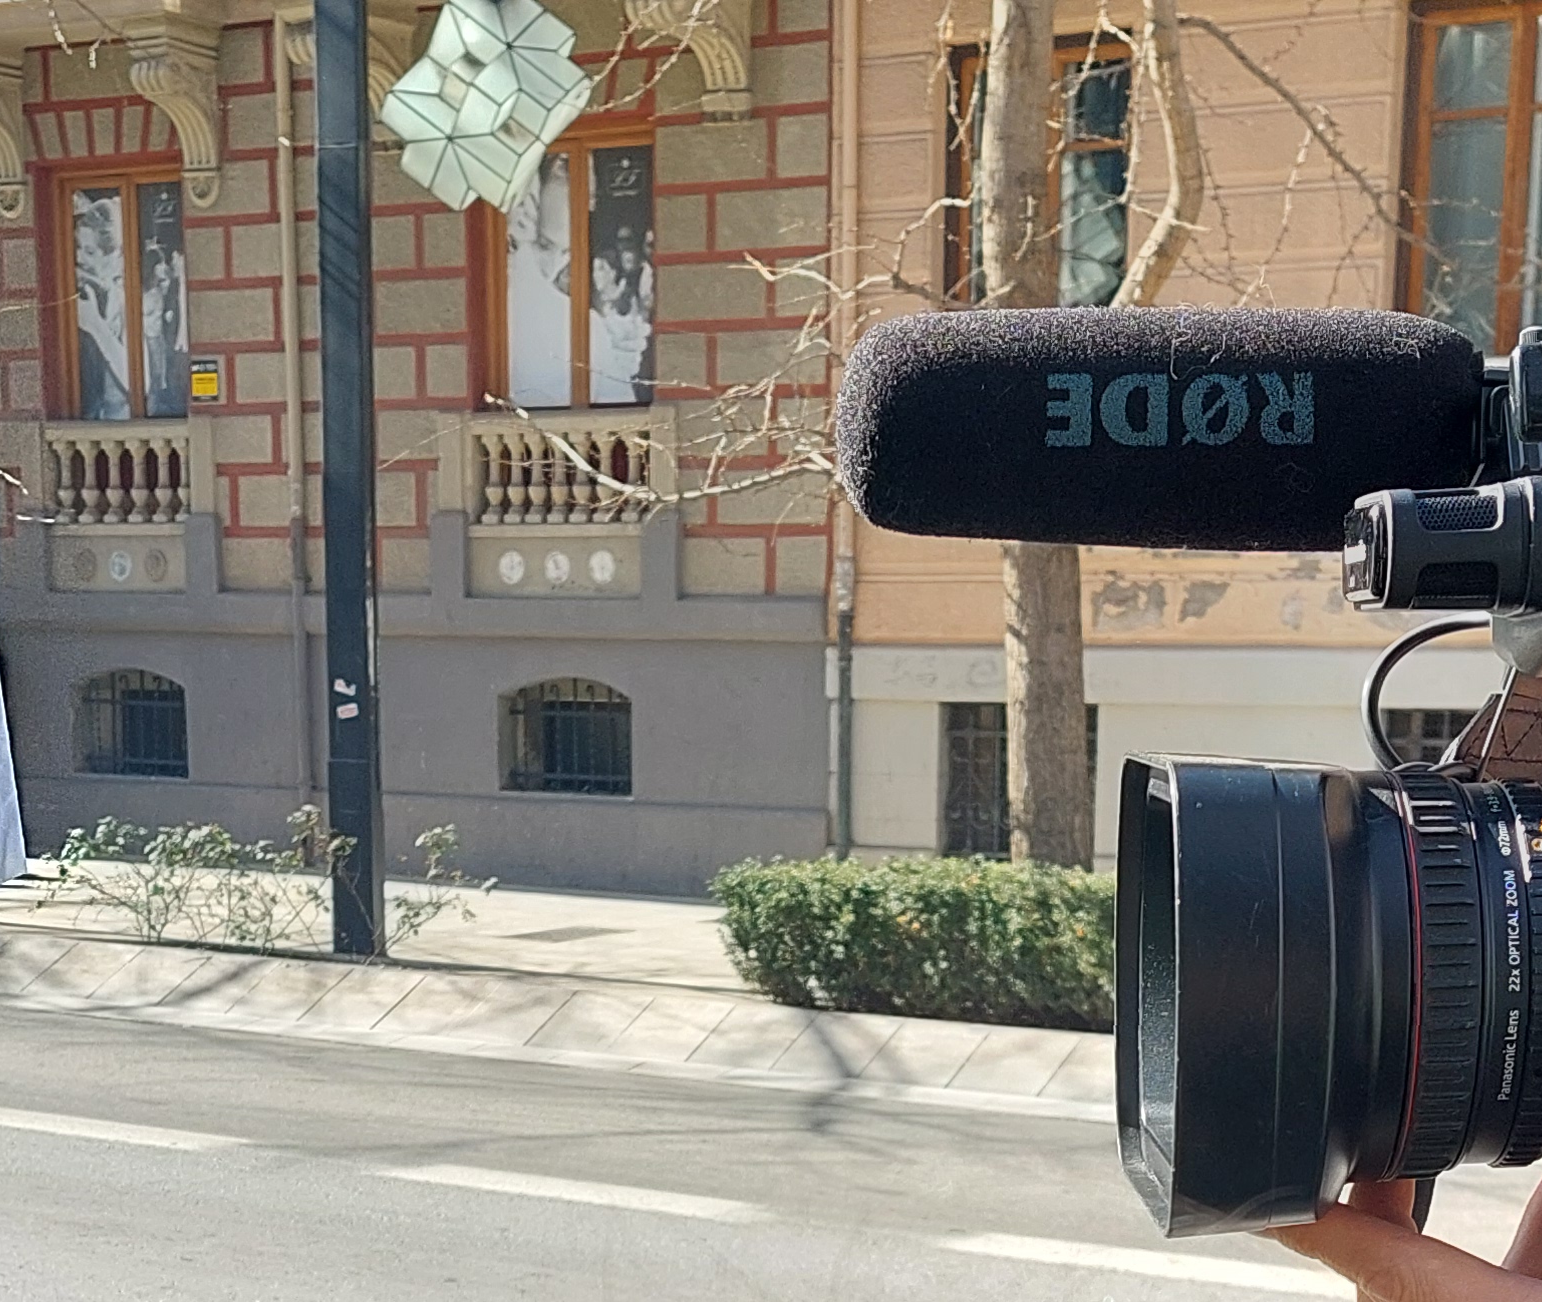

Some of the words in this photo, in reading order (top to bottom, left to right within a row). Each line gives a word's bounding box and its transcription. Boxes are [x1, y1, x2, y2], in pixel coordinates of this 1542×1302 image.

[1045, 370, 1314, 446] RØDE
[1503, 870, 1518, 907] ZOOM
[1509, 910, 1520, 966] OPTICAL
[1509, 969, 1520, 992] 22x
[1505, 1009, 1520, 1041] Lens
[1498, 1041, 1517, 1101] Panasonic
